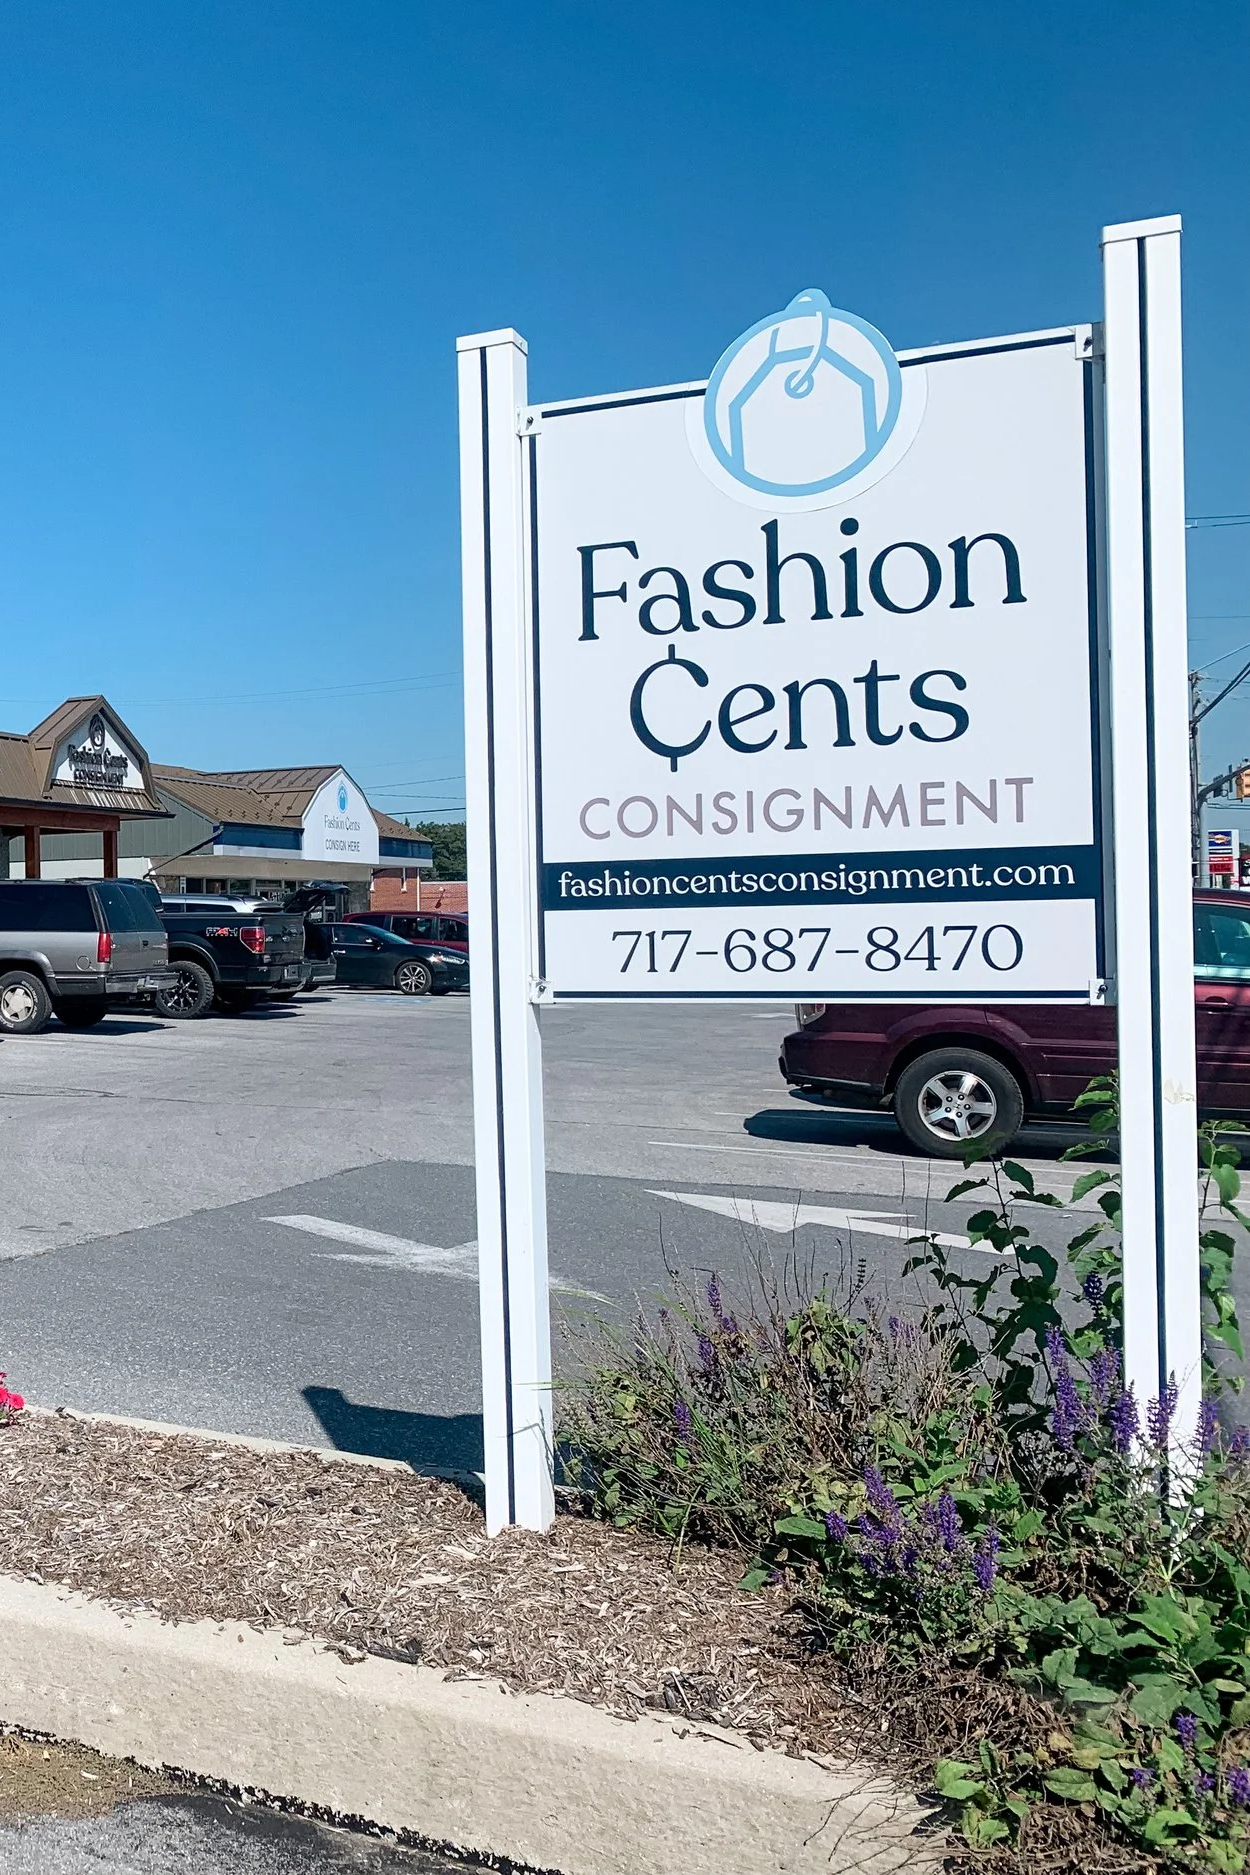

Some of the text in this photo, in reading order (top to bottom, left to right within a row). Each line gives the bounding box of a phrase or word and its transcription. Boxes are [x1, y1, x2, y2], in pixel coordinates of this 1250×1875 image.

[577, 518, 1027, 641] Fashion
[324, 815, 345, 830] Fashion
[580, 777, 1034, 840] CONSIGNMENT
[325, 839, 360, 852] CONSIGN HERE
[558, 864, 1075, 896] fashioncentsconsignment.com
[612, 925, 1023, 972] 717-687-8470
